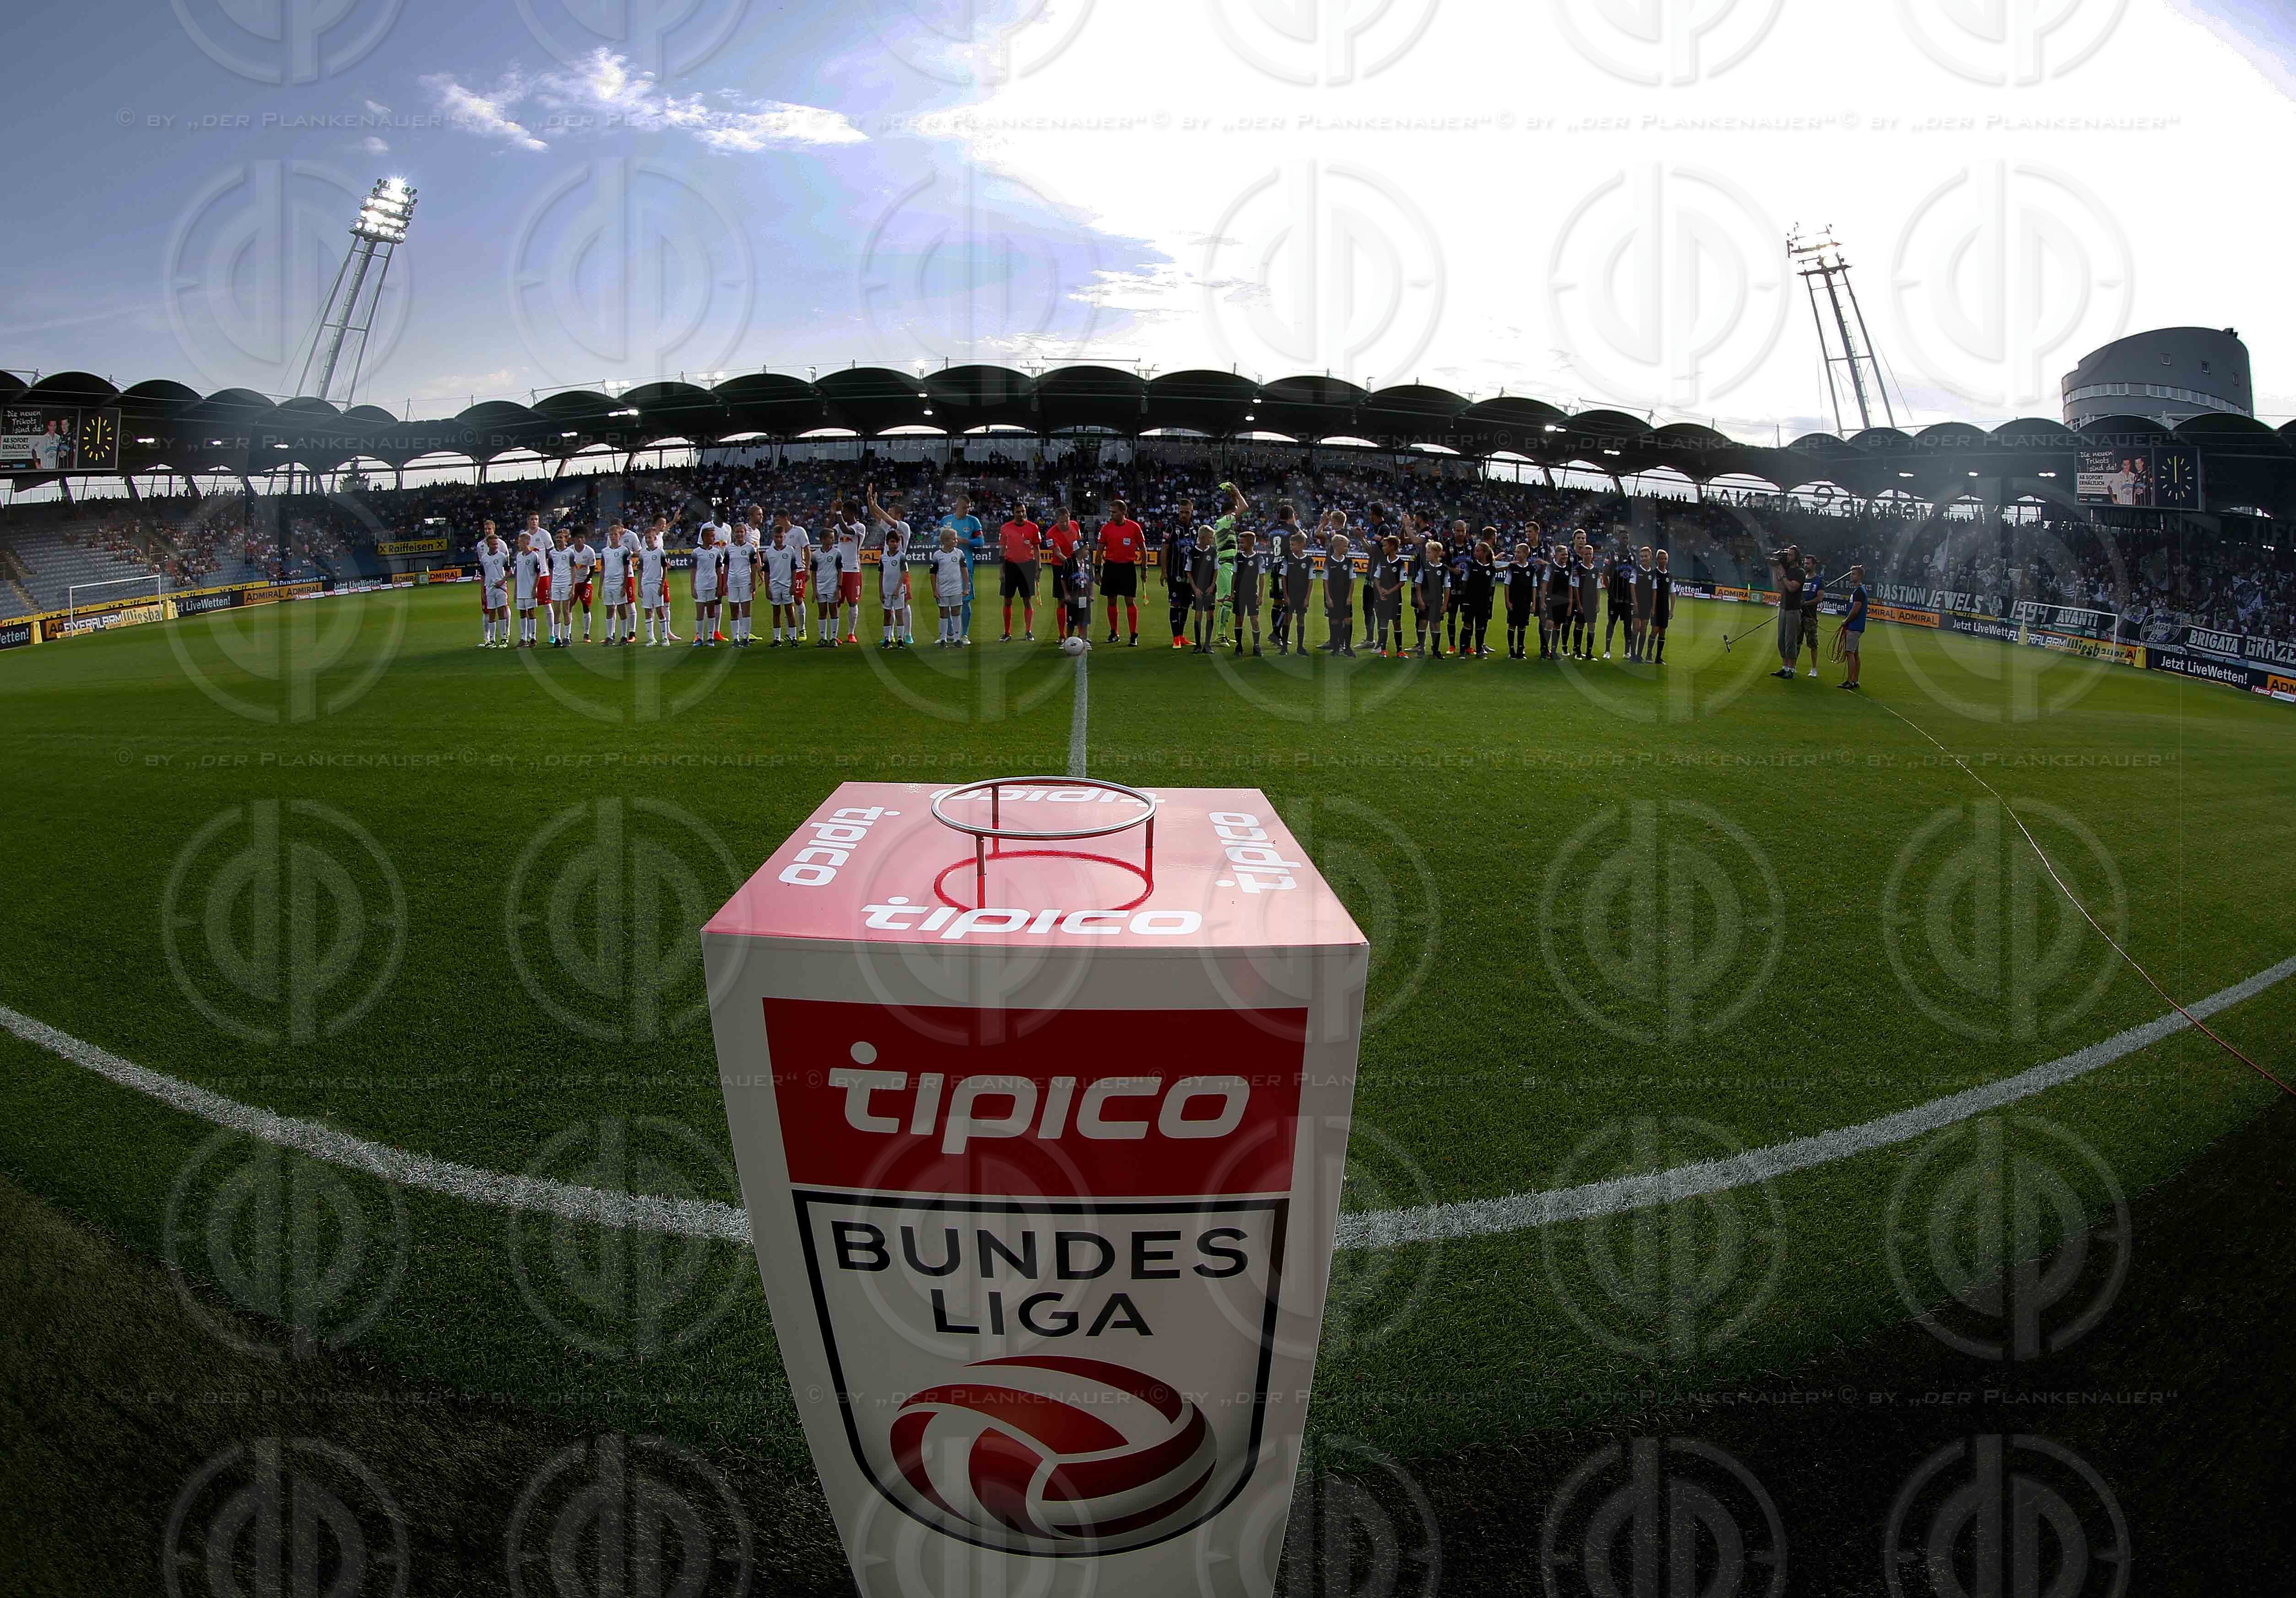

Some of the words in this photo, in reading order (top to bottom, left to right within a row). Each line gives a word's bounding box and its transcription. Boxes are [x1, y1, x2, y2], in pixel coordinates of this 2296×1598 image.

[389, 540, 433, 553] Raiffeisen
[1273, 536, 1281, 556] 8
[905, 552, 926, 561] etzt
[796, 579, 803, 588] 22
[1675, 584, 1702, 594] Wetten!
[246, 589, 283, 602] ADMIRAL
[287, 585, 320, 595] ADMIRAL
[1877, 582, 1925, 605] BASTION
[1928, 589, 1983, 614] JEWELS
[187, 596, 230, 611] LiveWetten!
[1899, 612, 1938, 625] ADMIRAL
[1953, 619, 1971, 631] Jetzt
[2056, 609, 2099, 627] AVANTI
[0, 628, 29, 644] etten!
[2188, 630, 2238, 653] BRIGATA
[2161, 655, 2184, 671] Jetzt
[2188, 660, 2248, 685] LiveWetten!
[778, 806, 901, 886] tipico
[1208, 811, 1302, 893] tipico
[861, 896, 1202, 939] tipico
[828, 1041, 1250, 1155] tipico
[830, 1220, 1250, 1281] BUNDES
[930, 1288, 1153, 1337] LIGA
